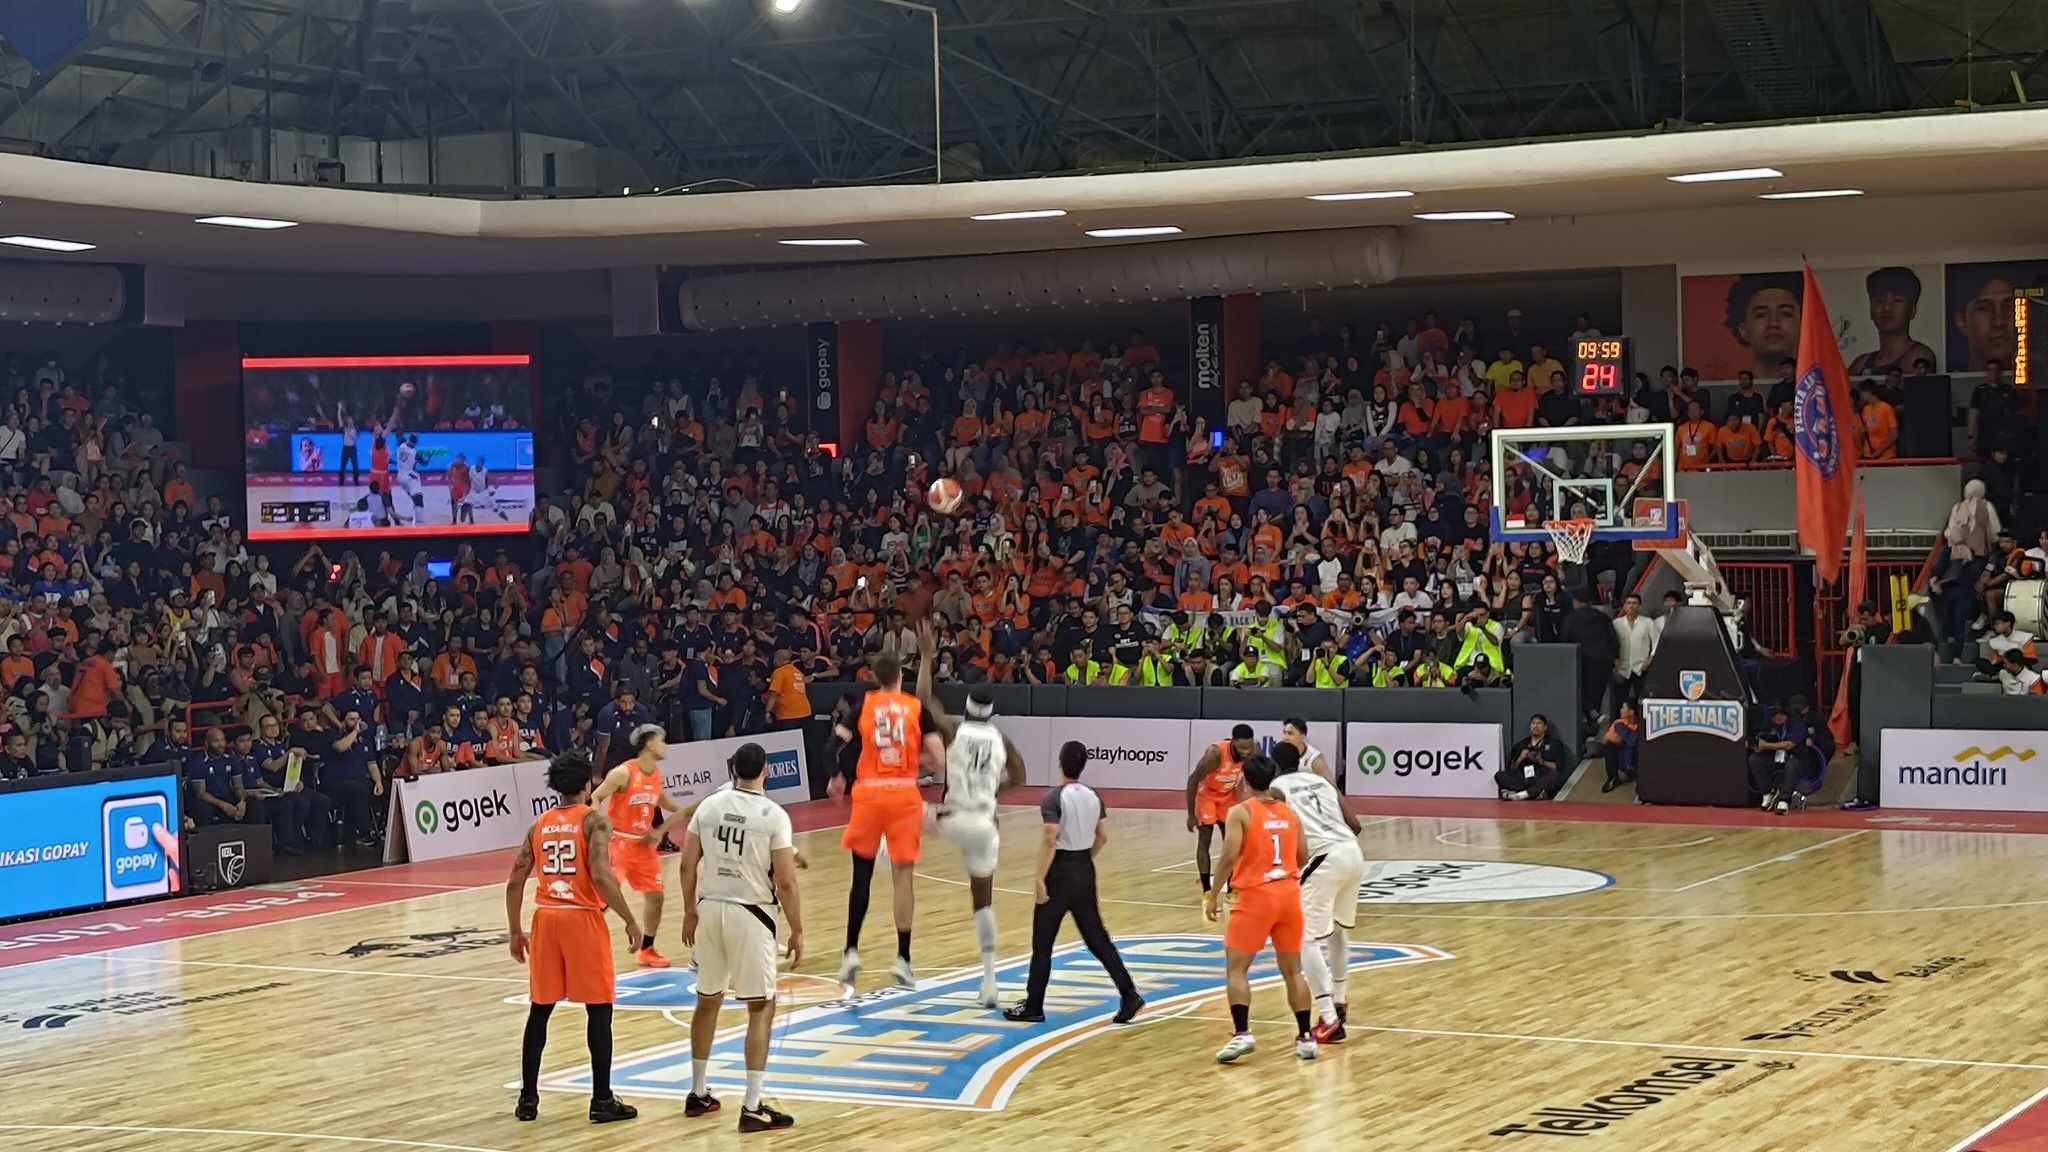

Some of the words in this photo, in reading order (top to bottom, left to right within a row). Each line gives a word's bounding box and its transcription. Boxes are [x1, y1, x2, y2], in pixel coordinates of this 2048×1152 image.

[817, 338, 831, 388] gopay
[1196, 323, 1210, 388] molten
[1578, 342, 1620, 358] 09:59
[1582, 364, 1615, 389] 24
[1648, 705, 1680, 731] THE
[1682, 705, 1738, 735] FINALS
[1393, 746, 1483, 776] gojek
[1899, 761, 2006, 785] mandiri
[663, 774, 691, 789] LITA
[692, 770, 712, 785] AIR
[442, 790, 511, 832] gojek
[42, 841, 89, 861] GOPAY
[718, 825, 745, 856] 44
[1272, 833, 1281, 864] 1
[116, 852, 157, 874] gopay
[542, 840, 577, 875] 32
[1360, 862, 1486, 889] gojek
[166, 883, 347, 918] 2024
[1489, 1056, 1748, 1136] Telkomsel
